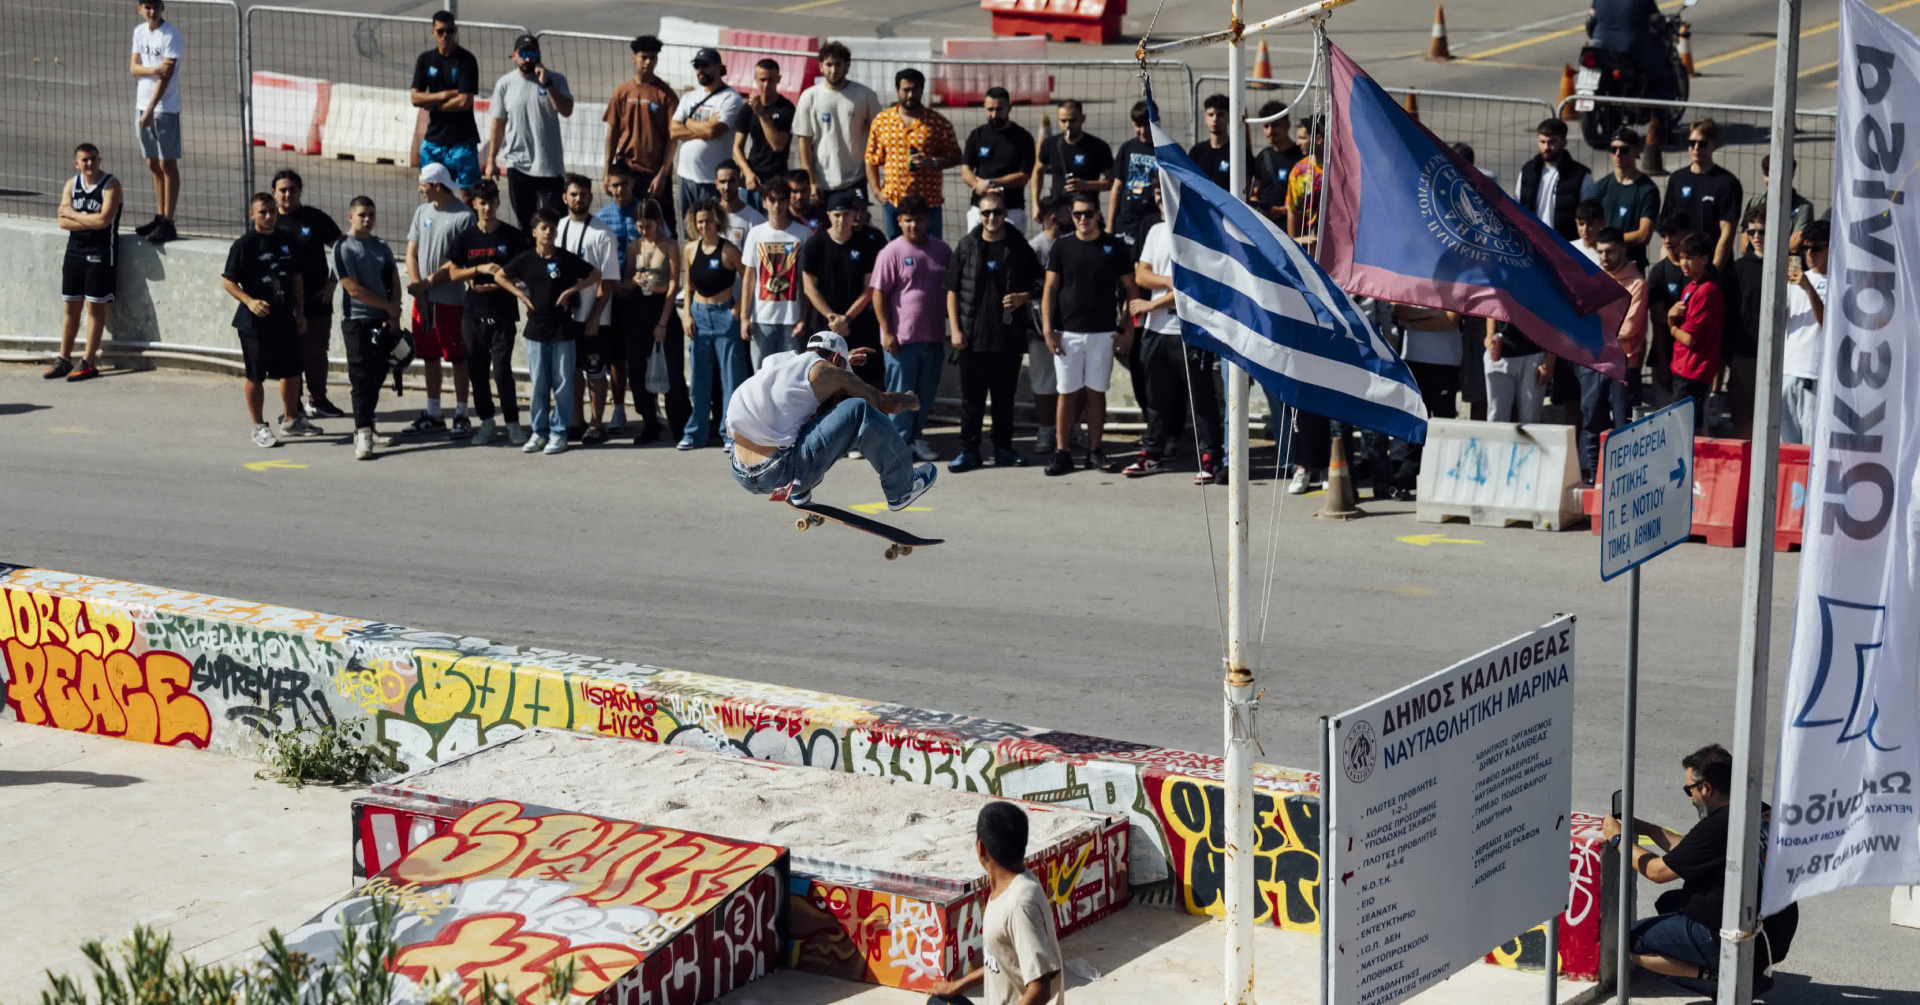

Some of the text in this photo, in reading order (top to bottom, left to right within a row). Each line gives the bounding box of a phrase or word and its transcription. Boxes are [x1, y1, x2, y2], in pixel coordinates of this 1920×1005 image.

[1610, 428, 1666, 471] ΠΕΡΙΦΕΡΕΙΑ
[1609, 464, 1649, 501] ΑΤΤΙΚΗΣ
[1608, 485, 1666, 530] Π. Ε. ΝΟΤΙΟΥ
[1608, 516, 1661, 561] ΤΟΜΕΑ ΑΘΗΝΩΝ
[6, 639, 213, 750] PEACE
[1382, 629, 1570, 737] ΔΗΜΟΣ ΚΑΛΛΙΘΕΑΣ
[1383, 663, 1569, 769] ΝΑΥΤΑΘΛΗΤΙΚΗ ΜΑΡΙΝΑ
[1475, 718, 1552, 761] ΑΘΛΗΤΙΚΟΣ ΟΡΓΑΝΙΣΜΟΣ
[1479, 730, 1548, 772] ΔΗΜΟΥ ΚΑΛΛΙΘΕΑΣ
[1475, 752, 1540, 790] ΓΡΑΦΕΙΟ ΔΙΑΧΕΙΡΙΣΗΣ
[1524, 756, 1553, 776] ΜΑΡΙΝΑΣ
[1366, 776, 1438, 816] ΠΛΩΤΕΣ ΠΡΟΒΛΗΤΕΣ
[1391, 803, 1408, 816] 1-2-3
[1475, 773, 1548, 816] ΓΗΠΕΔΟ ΠΟΔΟΣΦΑΙΡΟΥ
[1364, 812, 1437, 849] ΥΠΟΔΟΧΗΣ ΣΚΑΦΩΝ
[1366, 800, 1437, 840] ΧΩΡΟΣ ΠΡΟΣΩΡΙΝΗΣ
[1475, 805, 1513, 831] ΑΠΟΔΥΤΗΡΙΑ
[1503, 822, 1526, 840] ΧΩΡΟΣ
[1512, 826, 1540, 847] ΣΚΑΦΩΝ
[1363, 827, 1438, 868] ΠΛΩΤΕΣ ΠΡΟΒΛΗΤΕΣ
[1386, 856, 1405, 869] 4-5-6
[1474, 861, 1506, 887] ΑΠΟΘΗΚΕΣ
[1361, 897, 1375, 909] ΕΙΟ
[1361, 902, 1398, 924] ΣΕΑΝΑΤΚ
[1361, 909, 1416, 938] ΕΝΤΕΥΚΤΗΡΙΟ
[1384, 932, 1401, 945] ΔΕΗ
[1361, 933, 1429, 971] ΝΑΥΤΟΠΡΟΣΚΟΠΟΙ
[1361, 960, 1404, 986] ΑΠΟΘΗΚΕΣ
[1361, 968, 1420, 1002] ΝΑΥΤΑΘΛΗΤΙΚΕΣ
[1418, 961, 1451, 986] ΤΡΙΓΩΝΟΥ
